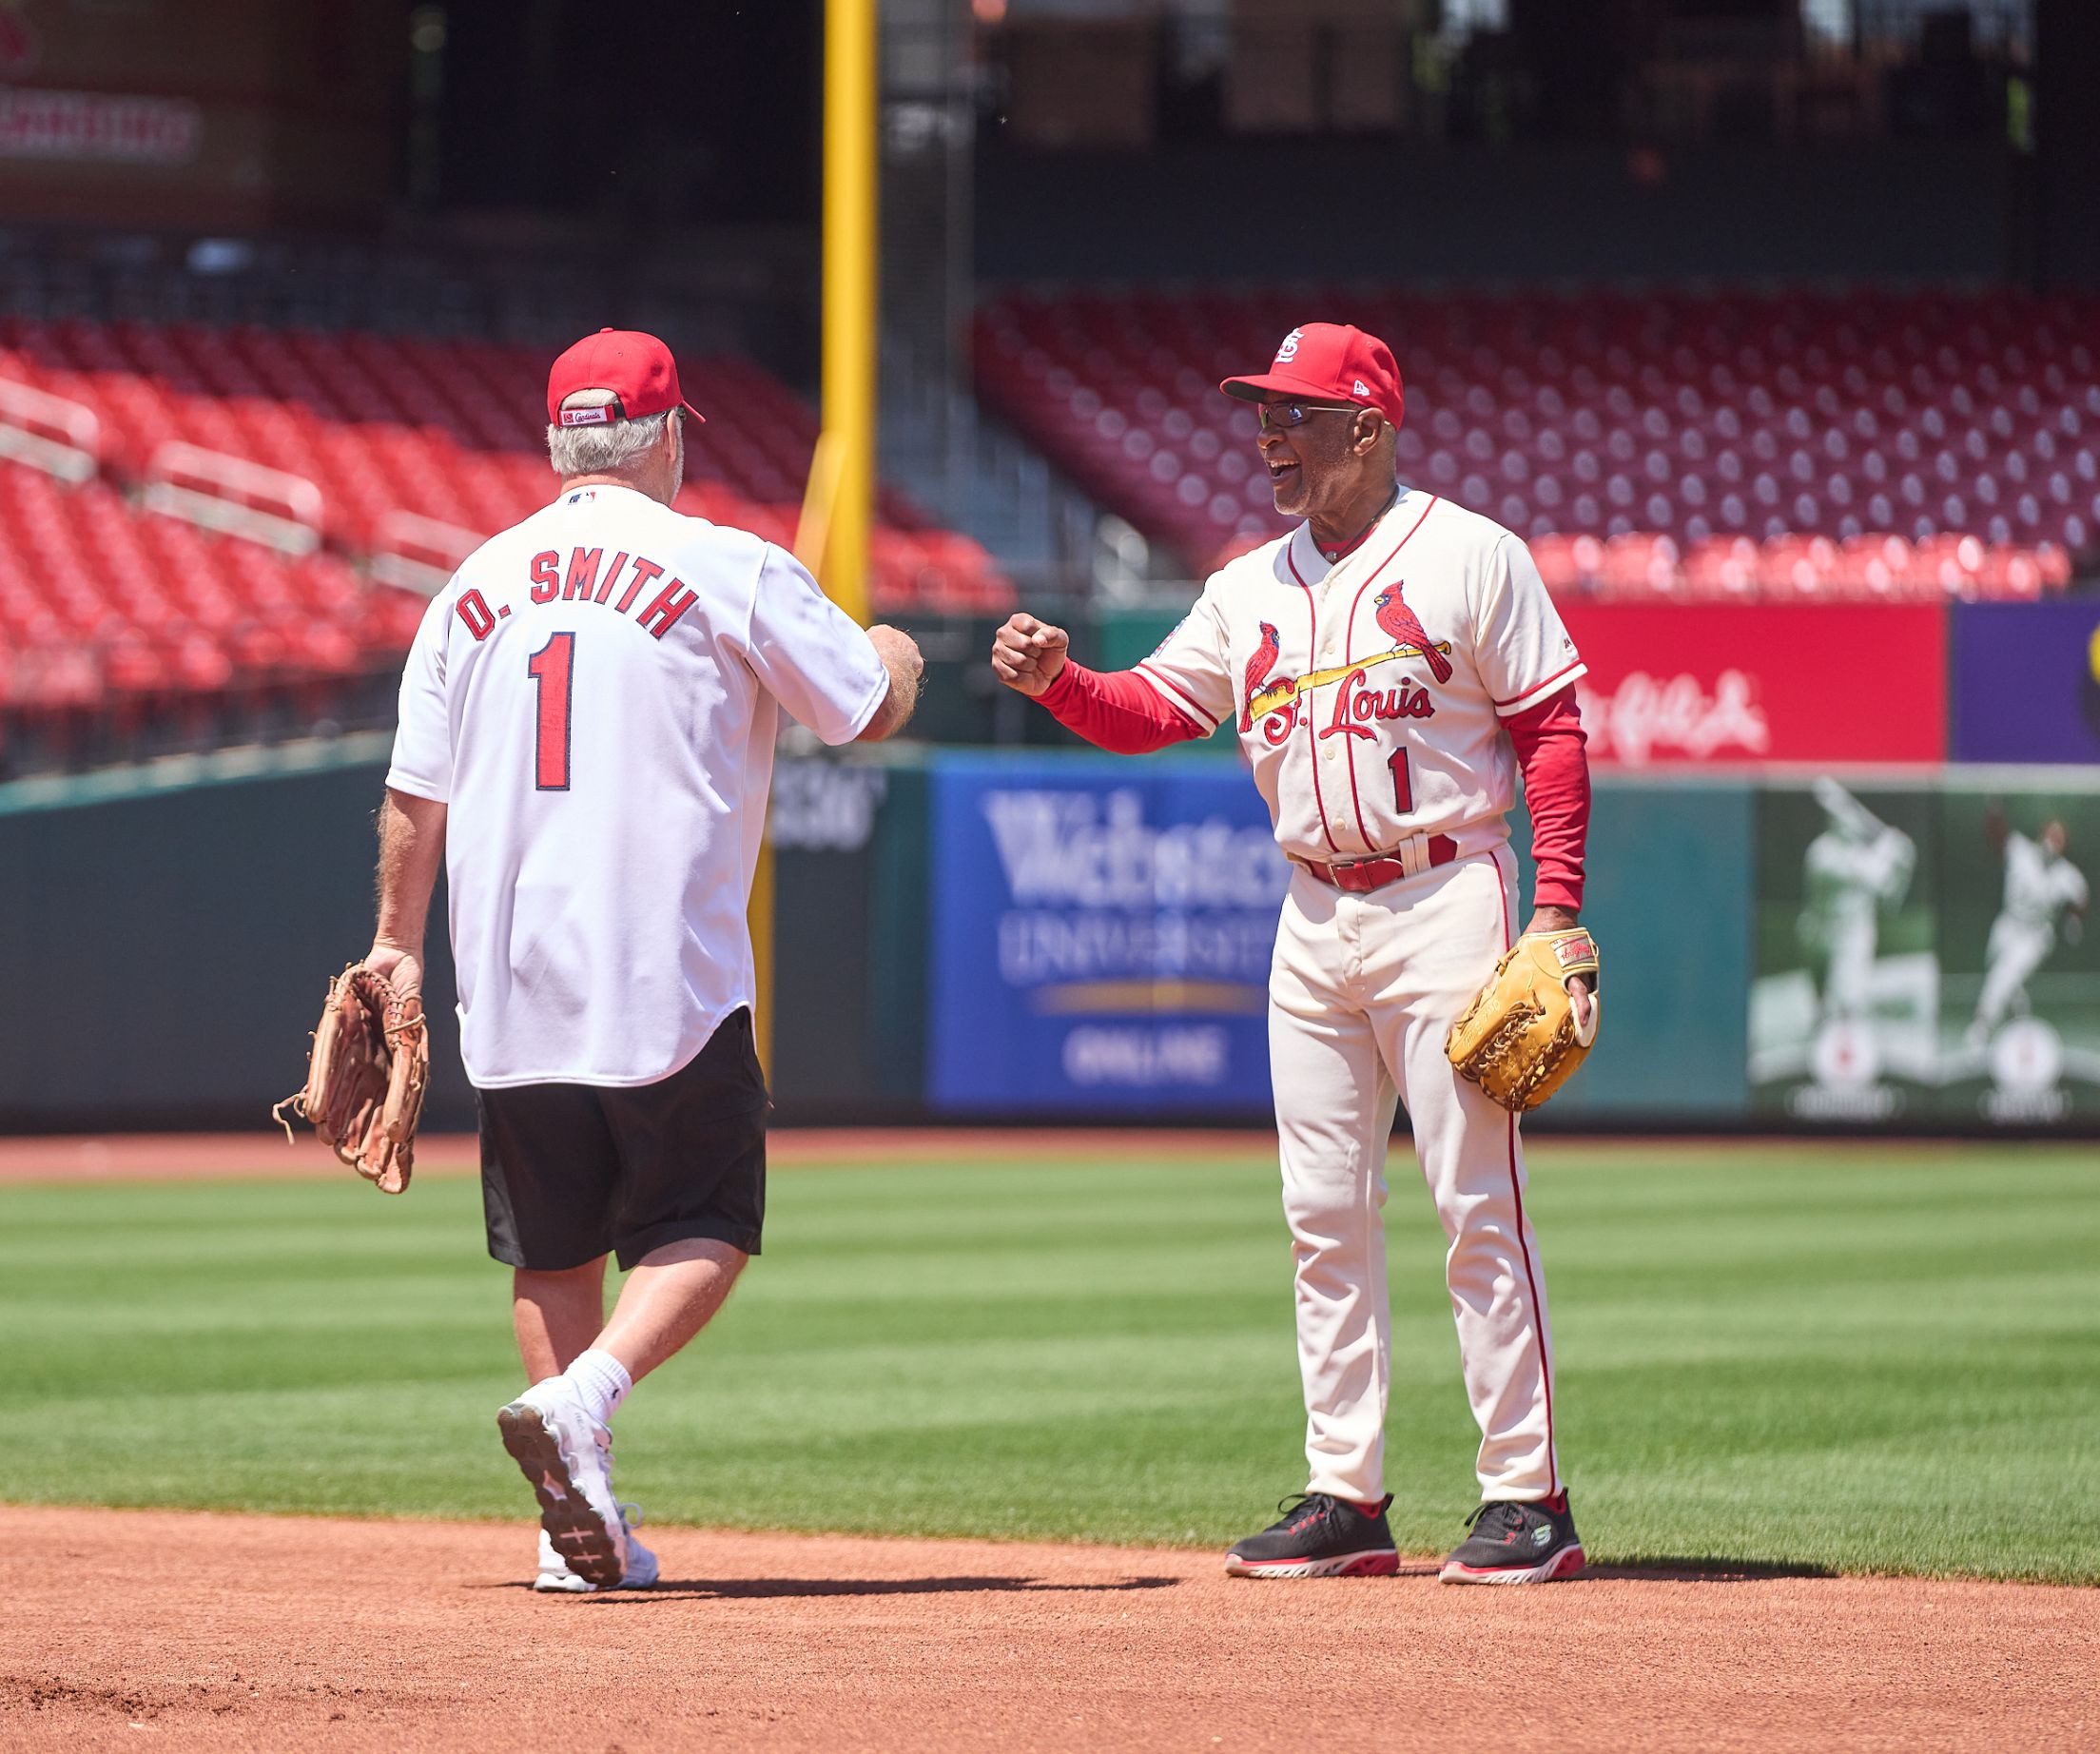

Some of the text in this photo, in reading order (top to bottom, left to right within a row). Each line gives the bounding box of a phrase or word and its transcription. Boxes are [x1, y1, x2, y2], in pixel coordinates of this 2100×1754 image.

[574, 412, 601, 422] Cardinals
[530, 546, 700, 641] SMITH
[527, 631, 576, 791] 1
[1318, 668, 1436, 742] Louis
[1387, 746, 1414, 815] 1
